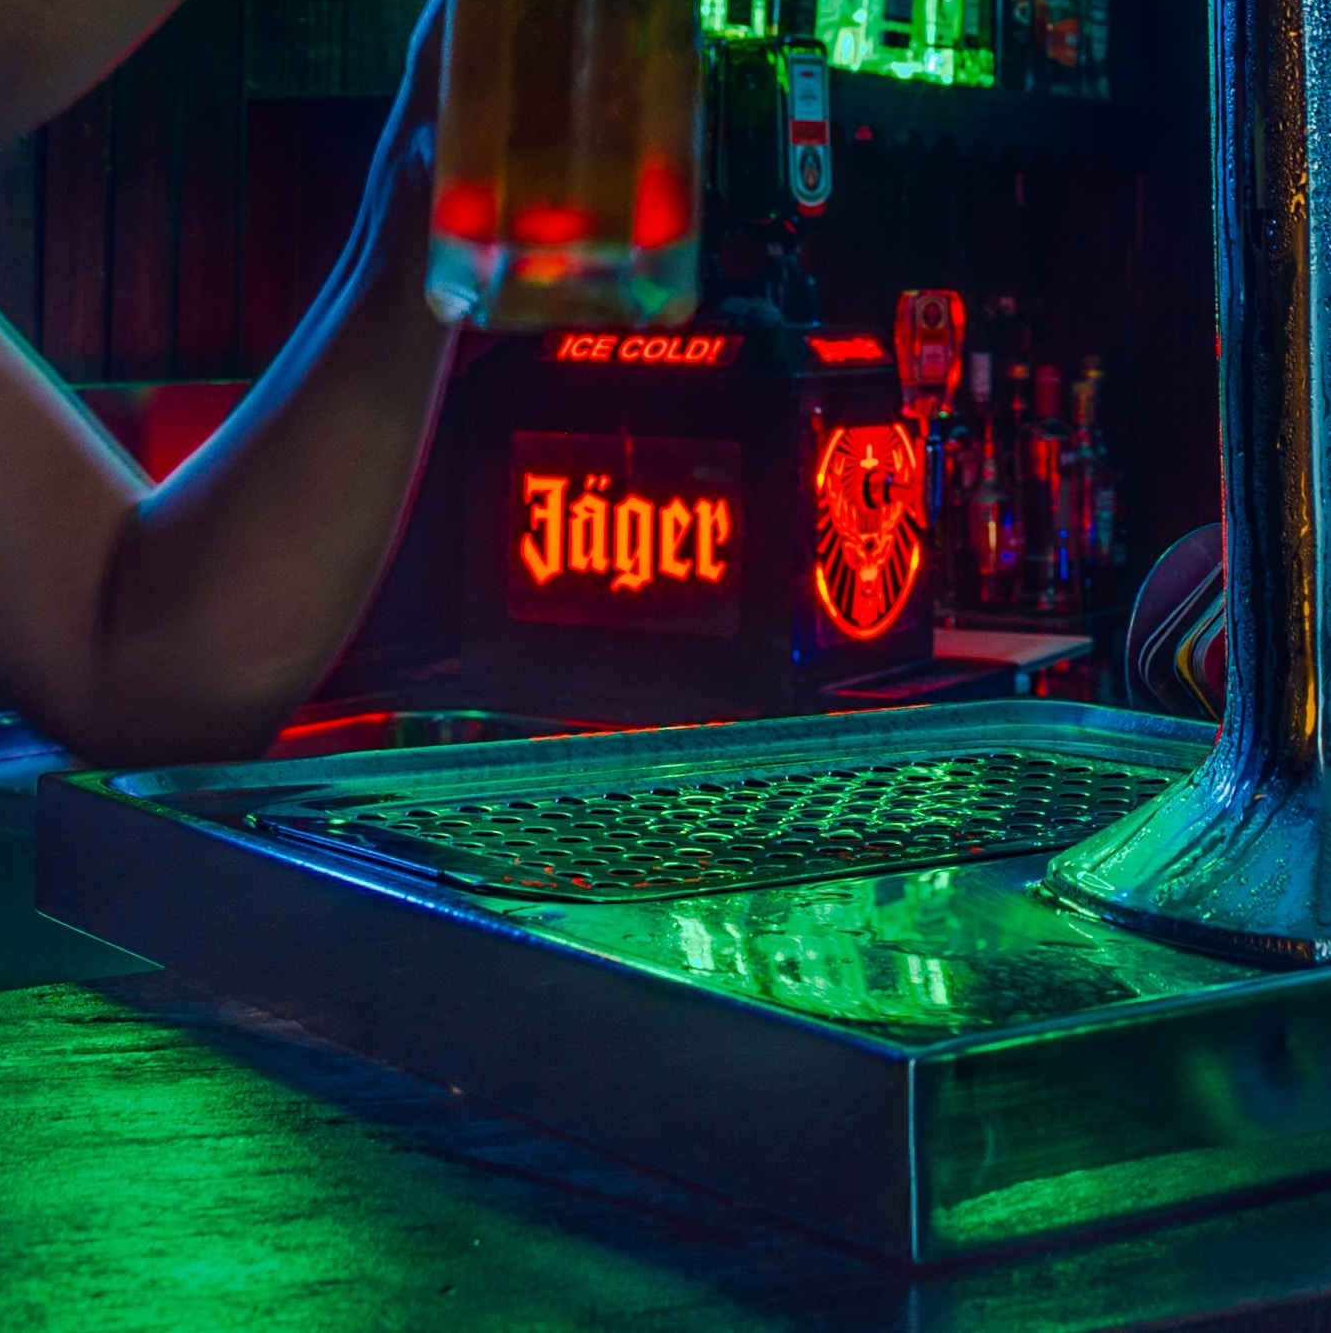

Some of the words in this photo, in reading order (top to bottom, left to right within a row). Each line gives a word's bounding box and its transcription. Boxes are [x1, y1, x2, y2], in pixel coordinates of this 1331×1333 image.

[557, 334, 618, 362] ICE
[618, 334, 726, 364] COLD!
[520, 471, 731, 592] Jäger
